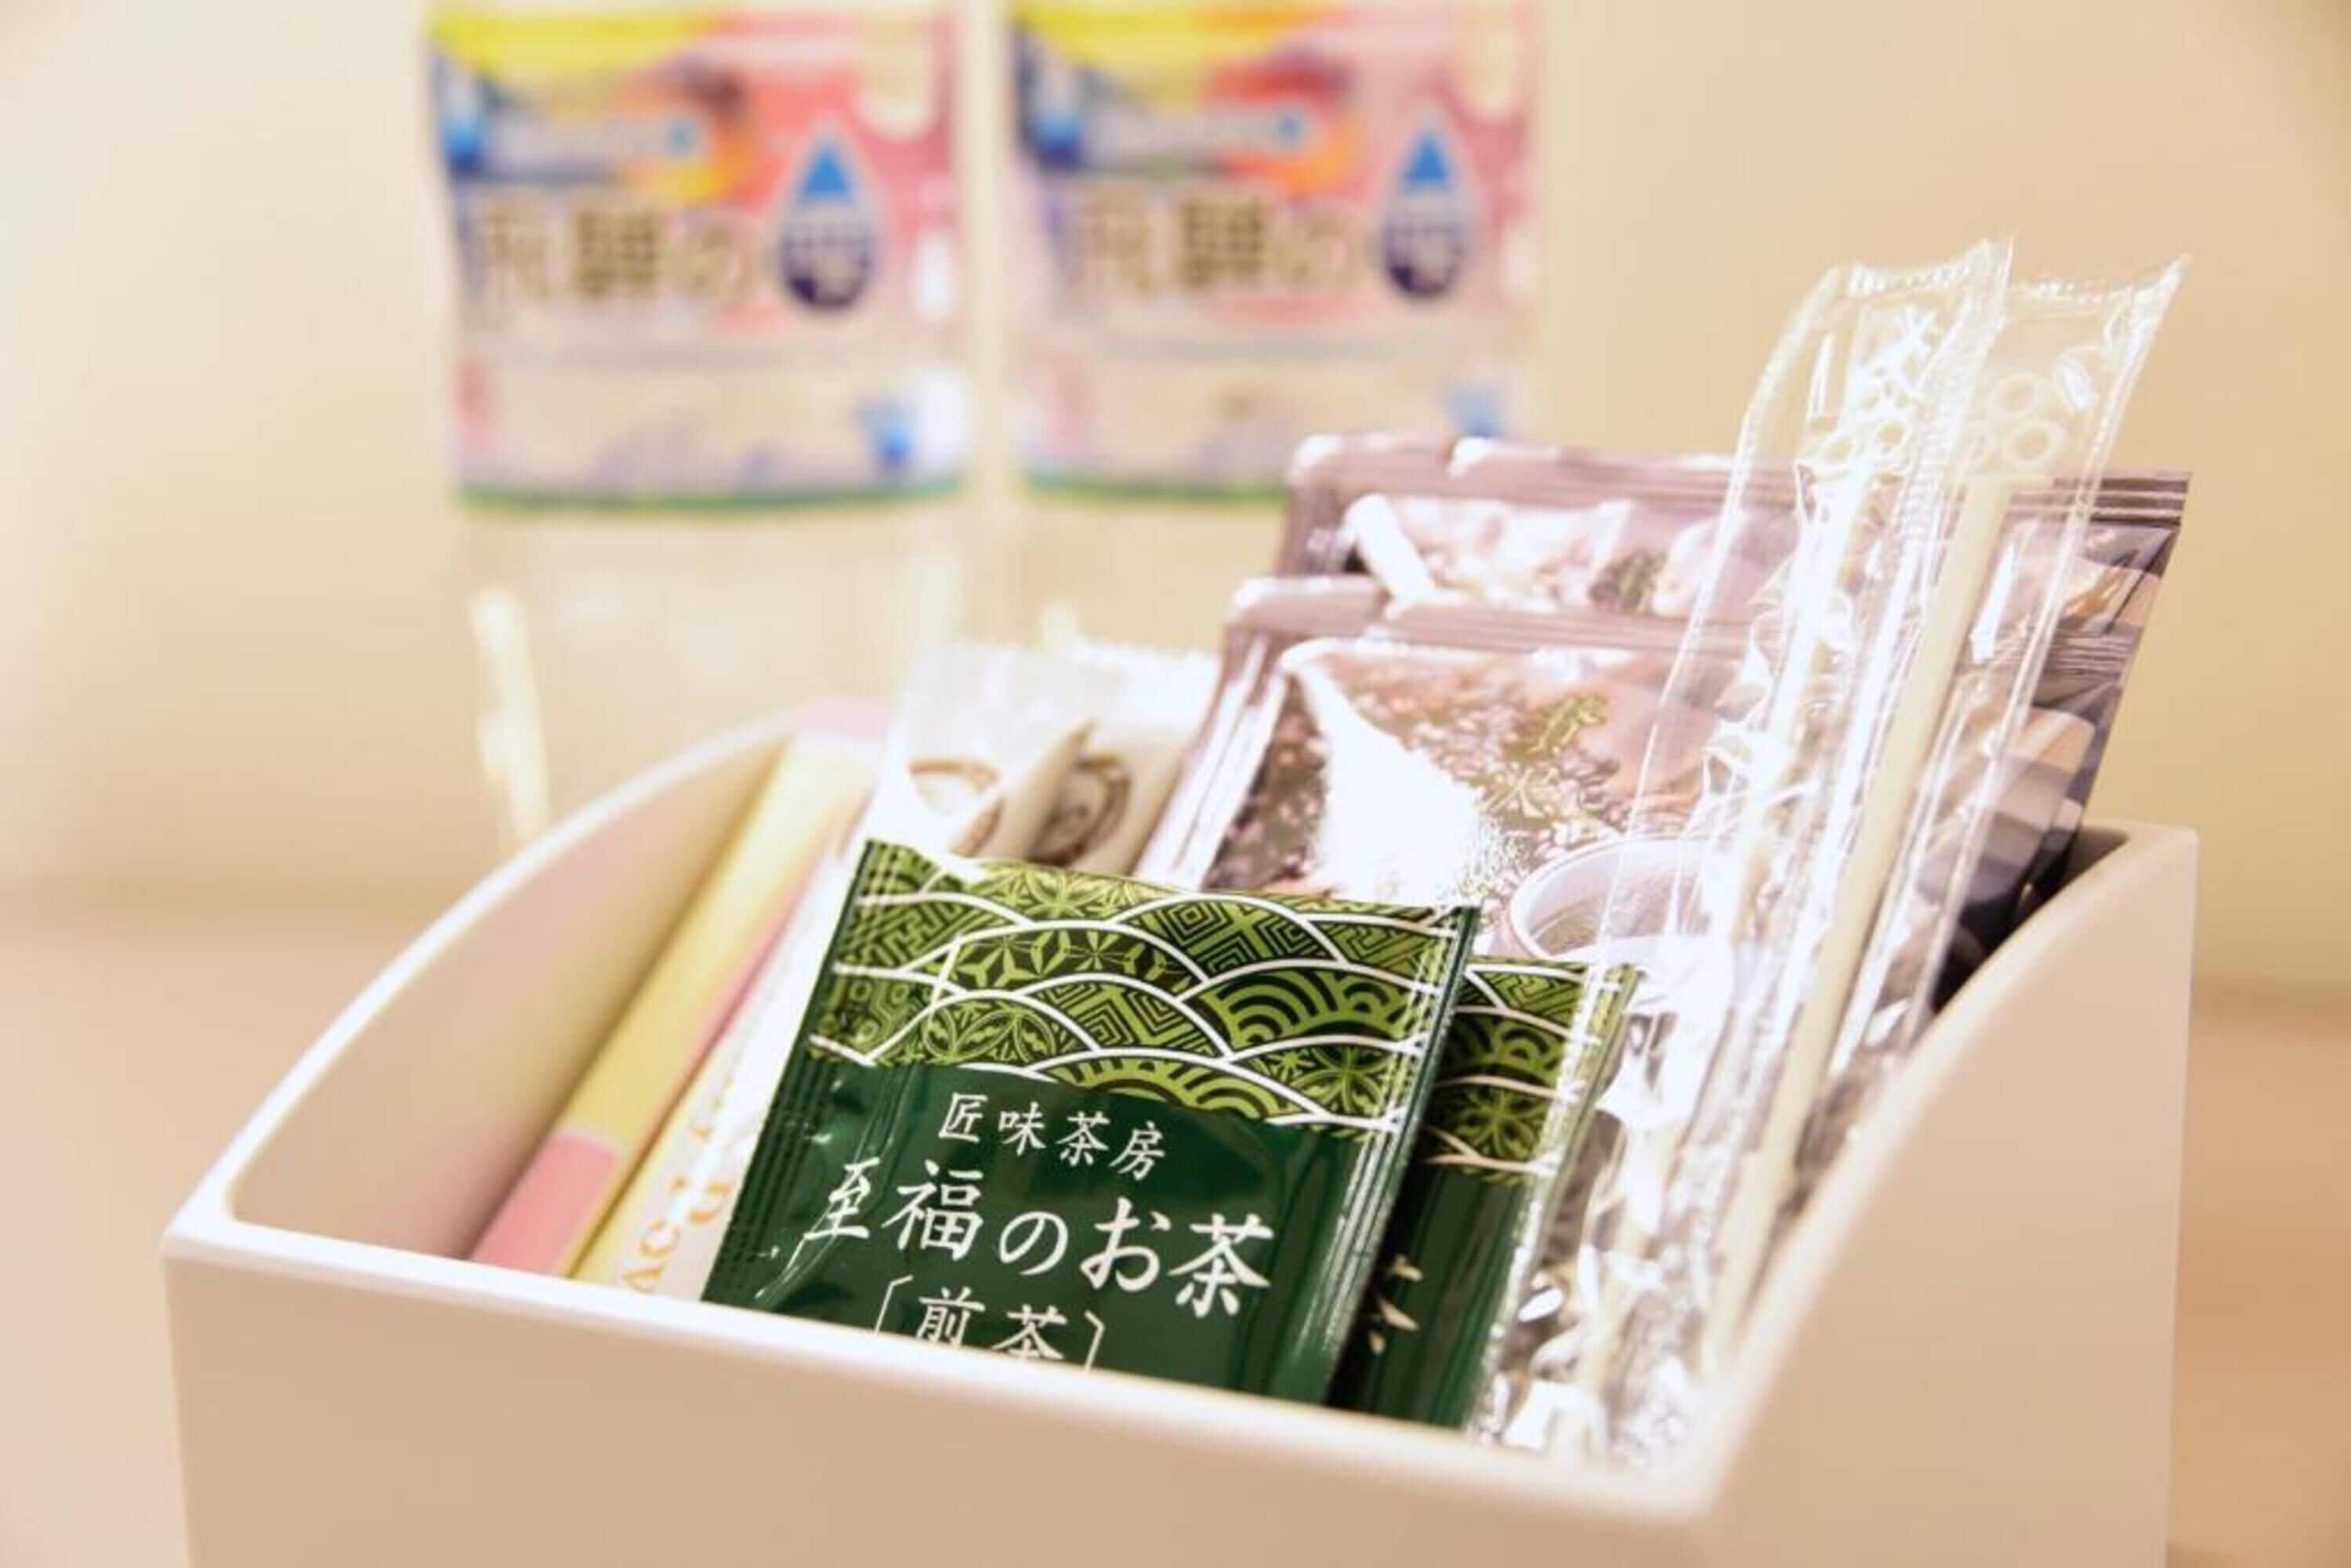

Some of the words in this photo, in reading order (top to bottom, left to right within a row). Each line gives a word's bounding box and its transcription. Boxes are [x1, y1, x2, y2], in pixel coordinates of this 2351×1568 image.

[938, 1092, 1167, 1181] 匠味茶房
[803, 1157, 1276, 1318] 至福のお茶
